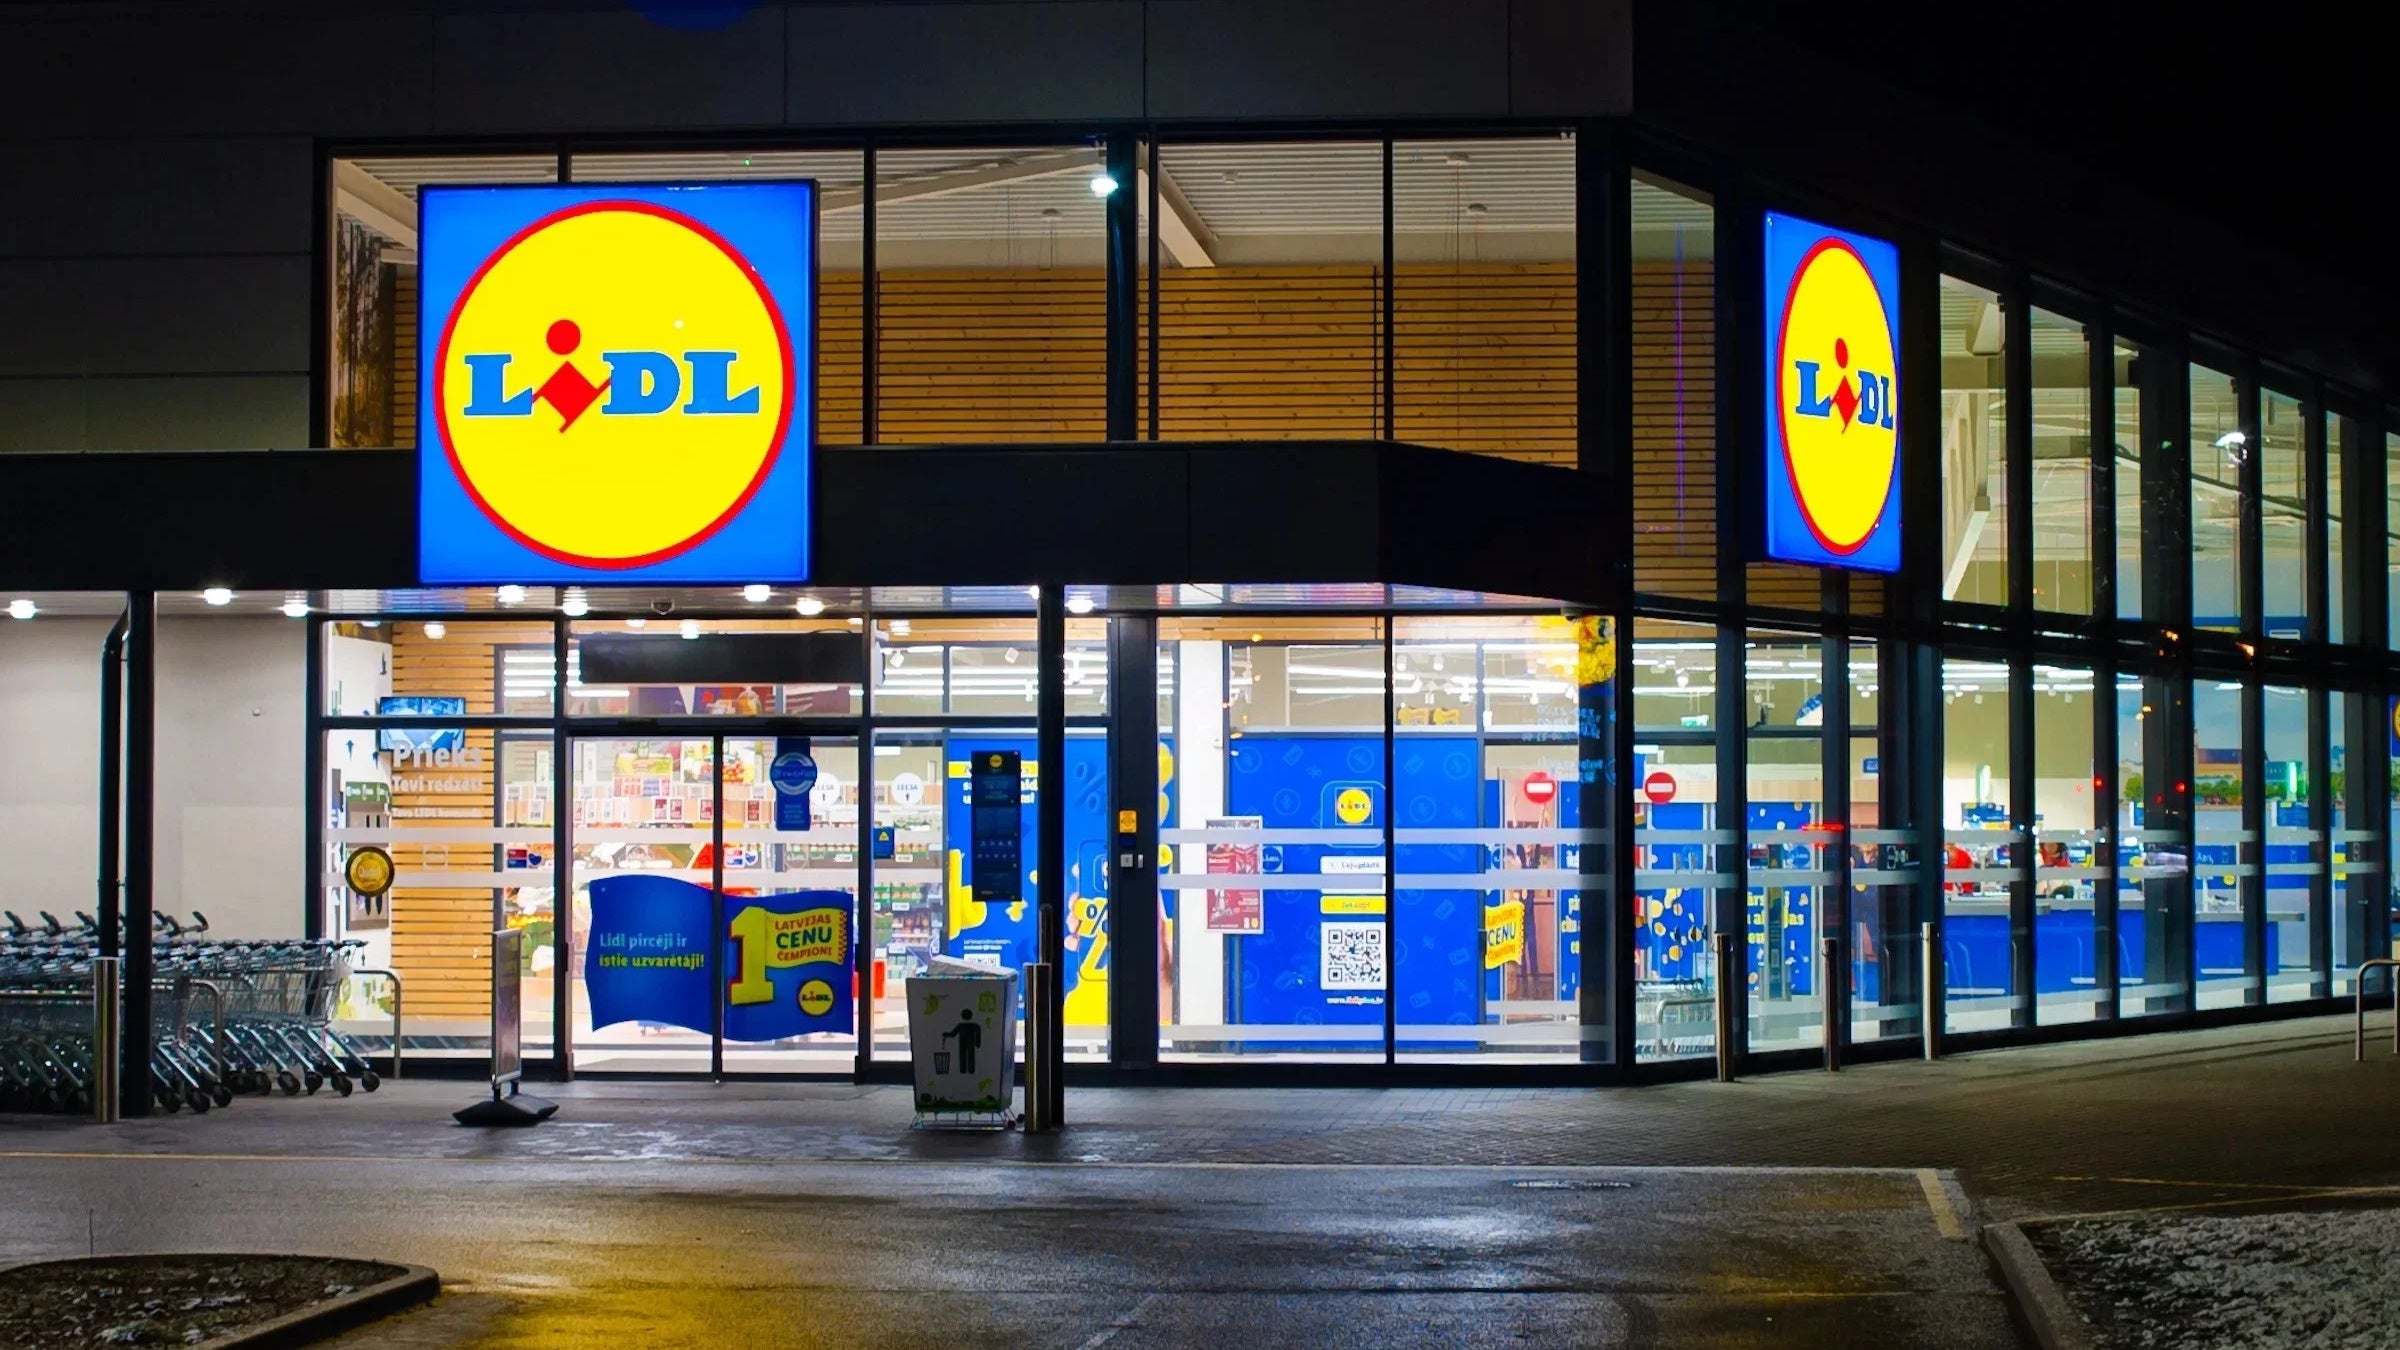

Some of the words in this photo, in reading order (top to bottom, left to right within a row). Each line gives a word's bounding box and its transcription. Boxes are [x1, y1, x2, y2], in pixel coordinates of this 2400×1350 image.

[392, 740, 483, 768] Prieks
[775, 914, 832, 931] LATVIJAS
[1488, 921, 1516, 947] CENU
[600, 932, 626, 947] Lidl
[677, 932, 688, 947] ir
[776, 926, 833, 949] CENU
